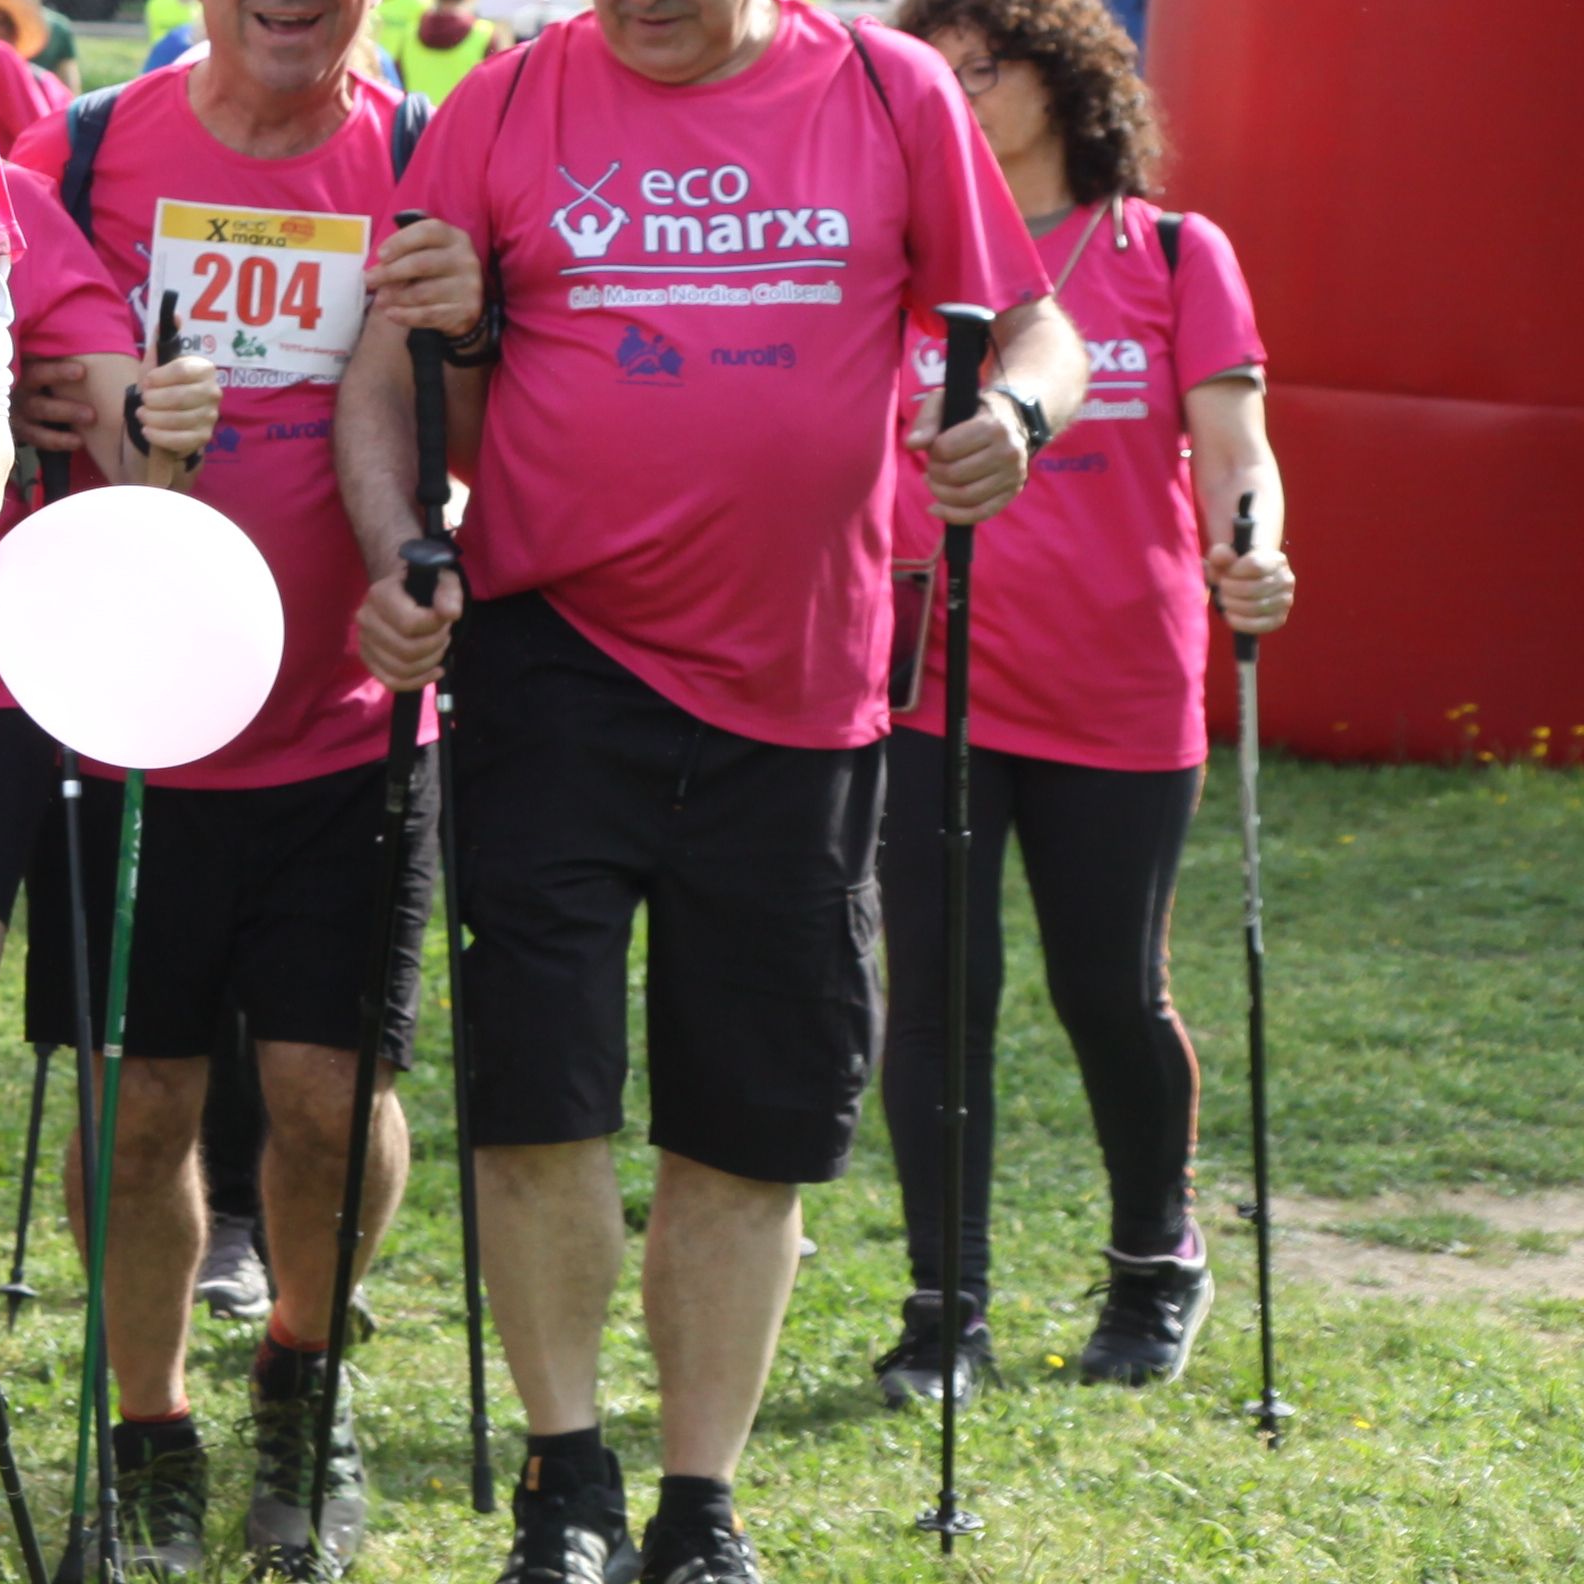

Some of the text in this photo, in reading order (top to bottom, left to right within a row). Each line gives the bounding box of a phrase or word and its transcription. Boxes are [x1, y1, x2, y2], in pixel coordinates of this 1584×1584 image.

[640, 163, 750, 207] eco
[643, 207, 851, 255] marxa
[189, 251, 323, 331] 204
[603, 284, 668, 307] Marxa
